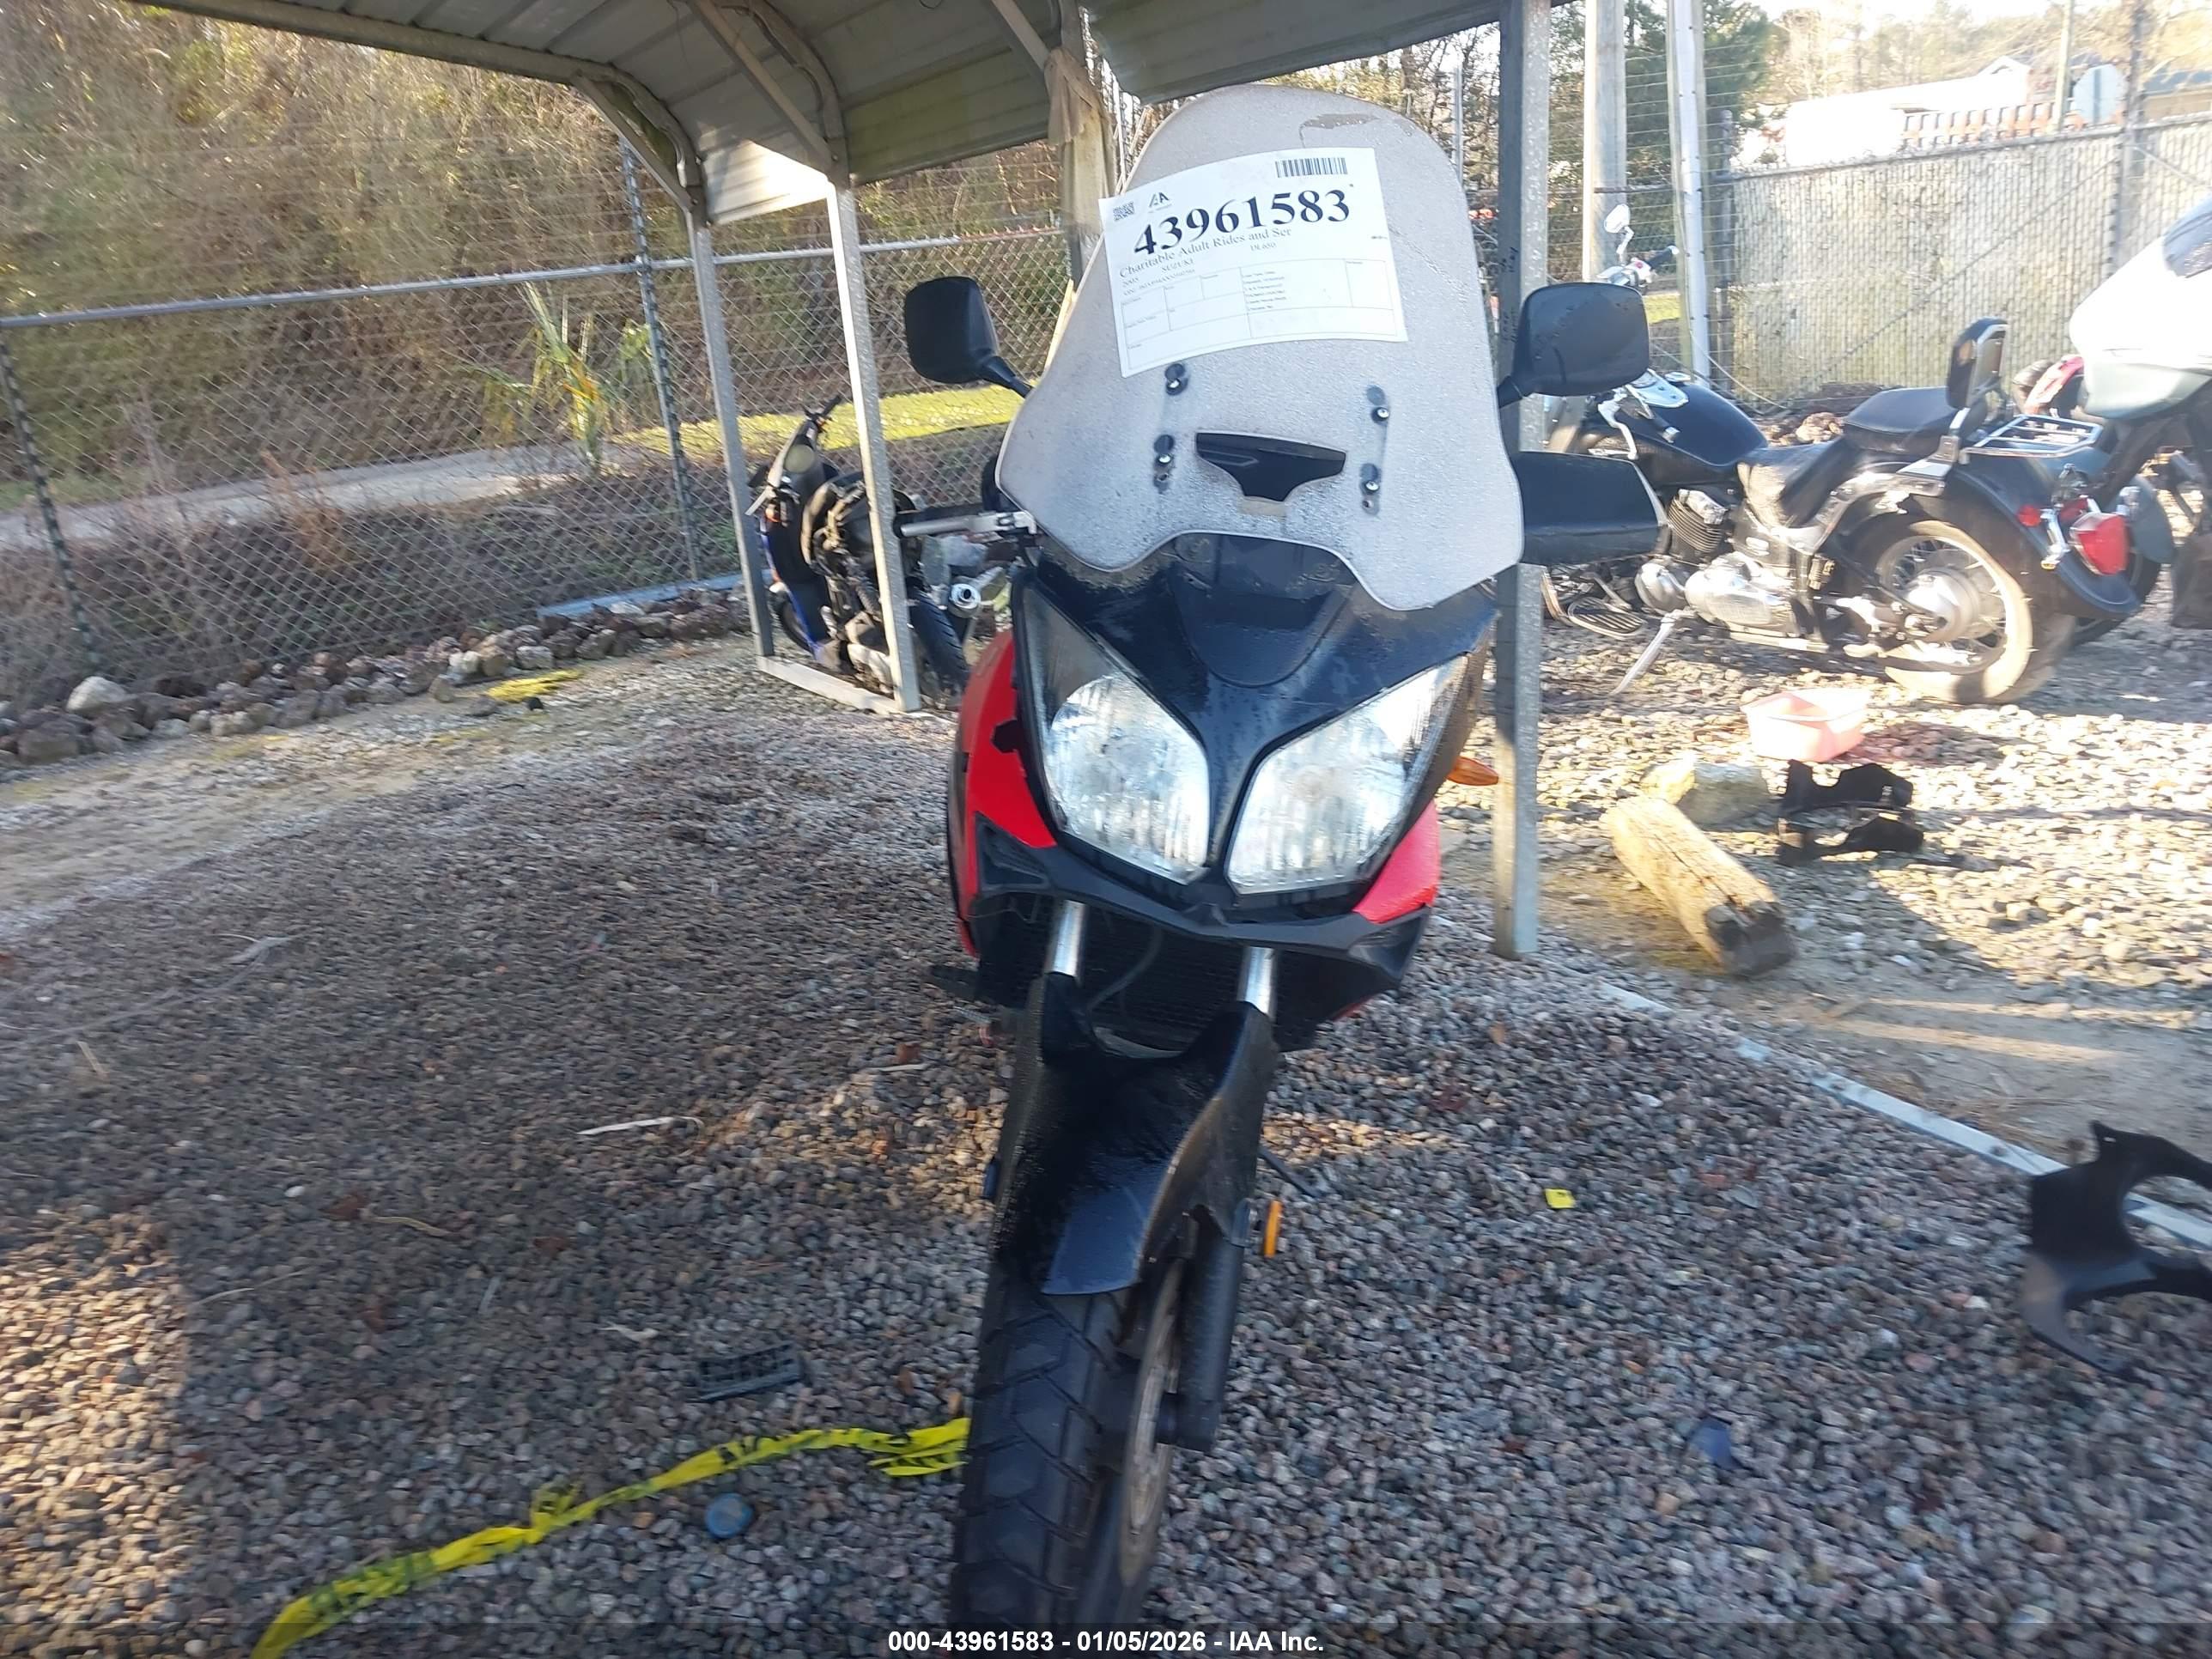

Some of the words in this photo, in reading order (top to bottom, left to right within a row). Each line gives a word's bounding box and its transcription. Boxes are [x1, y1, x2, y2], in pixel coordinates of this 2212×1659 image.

[1133, 189, 1351, 254] 43961583
[1119, 252, 1176, 277] Charitable
[1180, 241, 1210, 256] Adult
[1212, 235, 1246, 247] Rides
[1249, 228, 1270, 240] and
